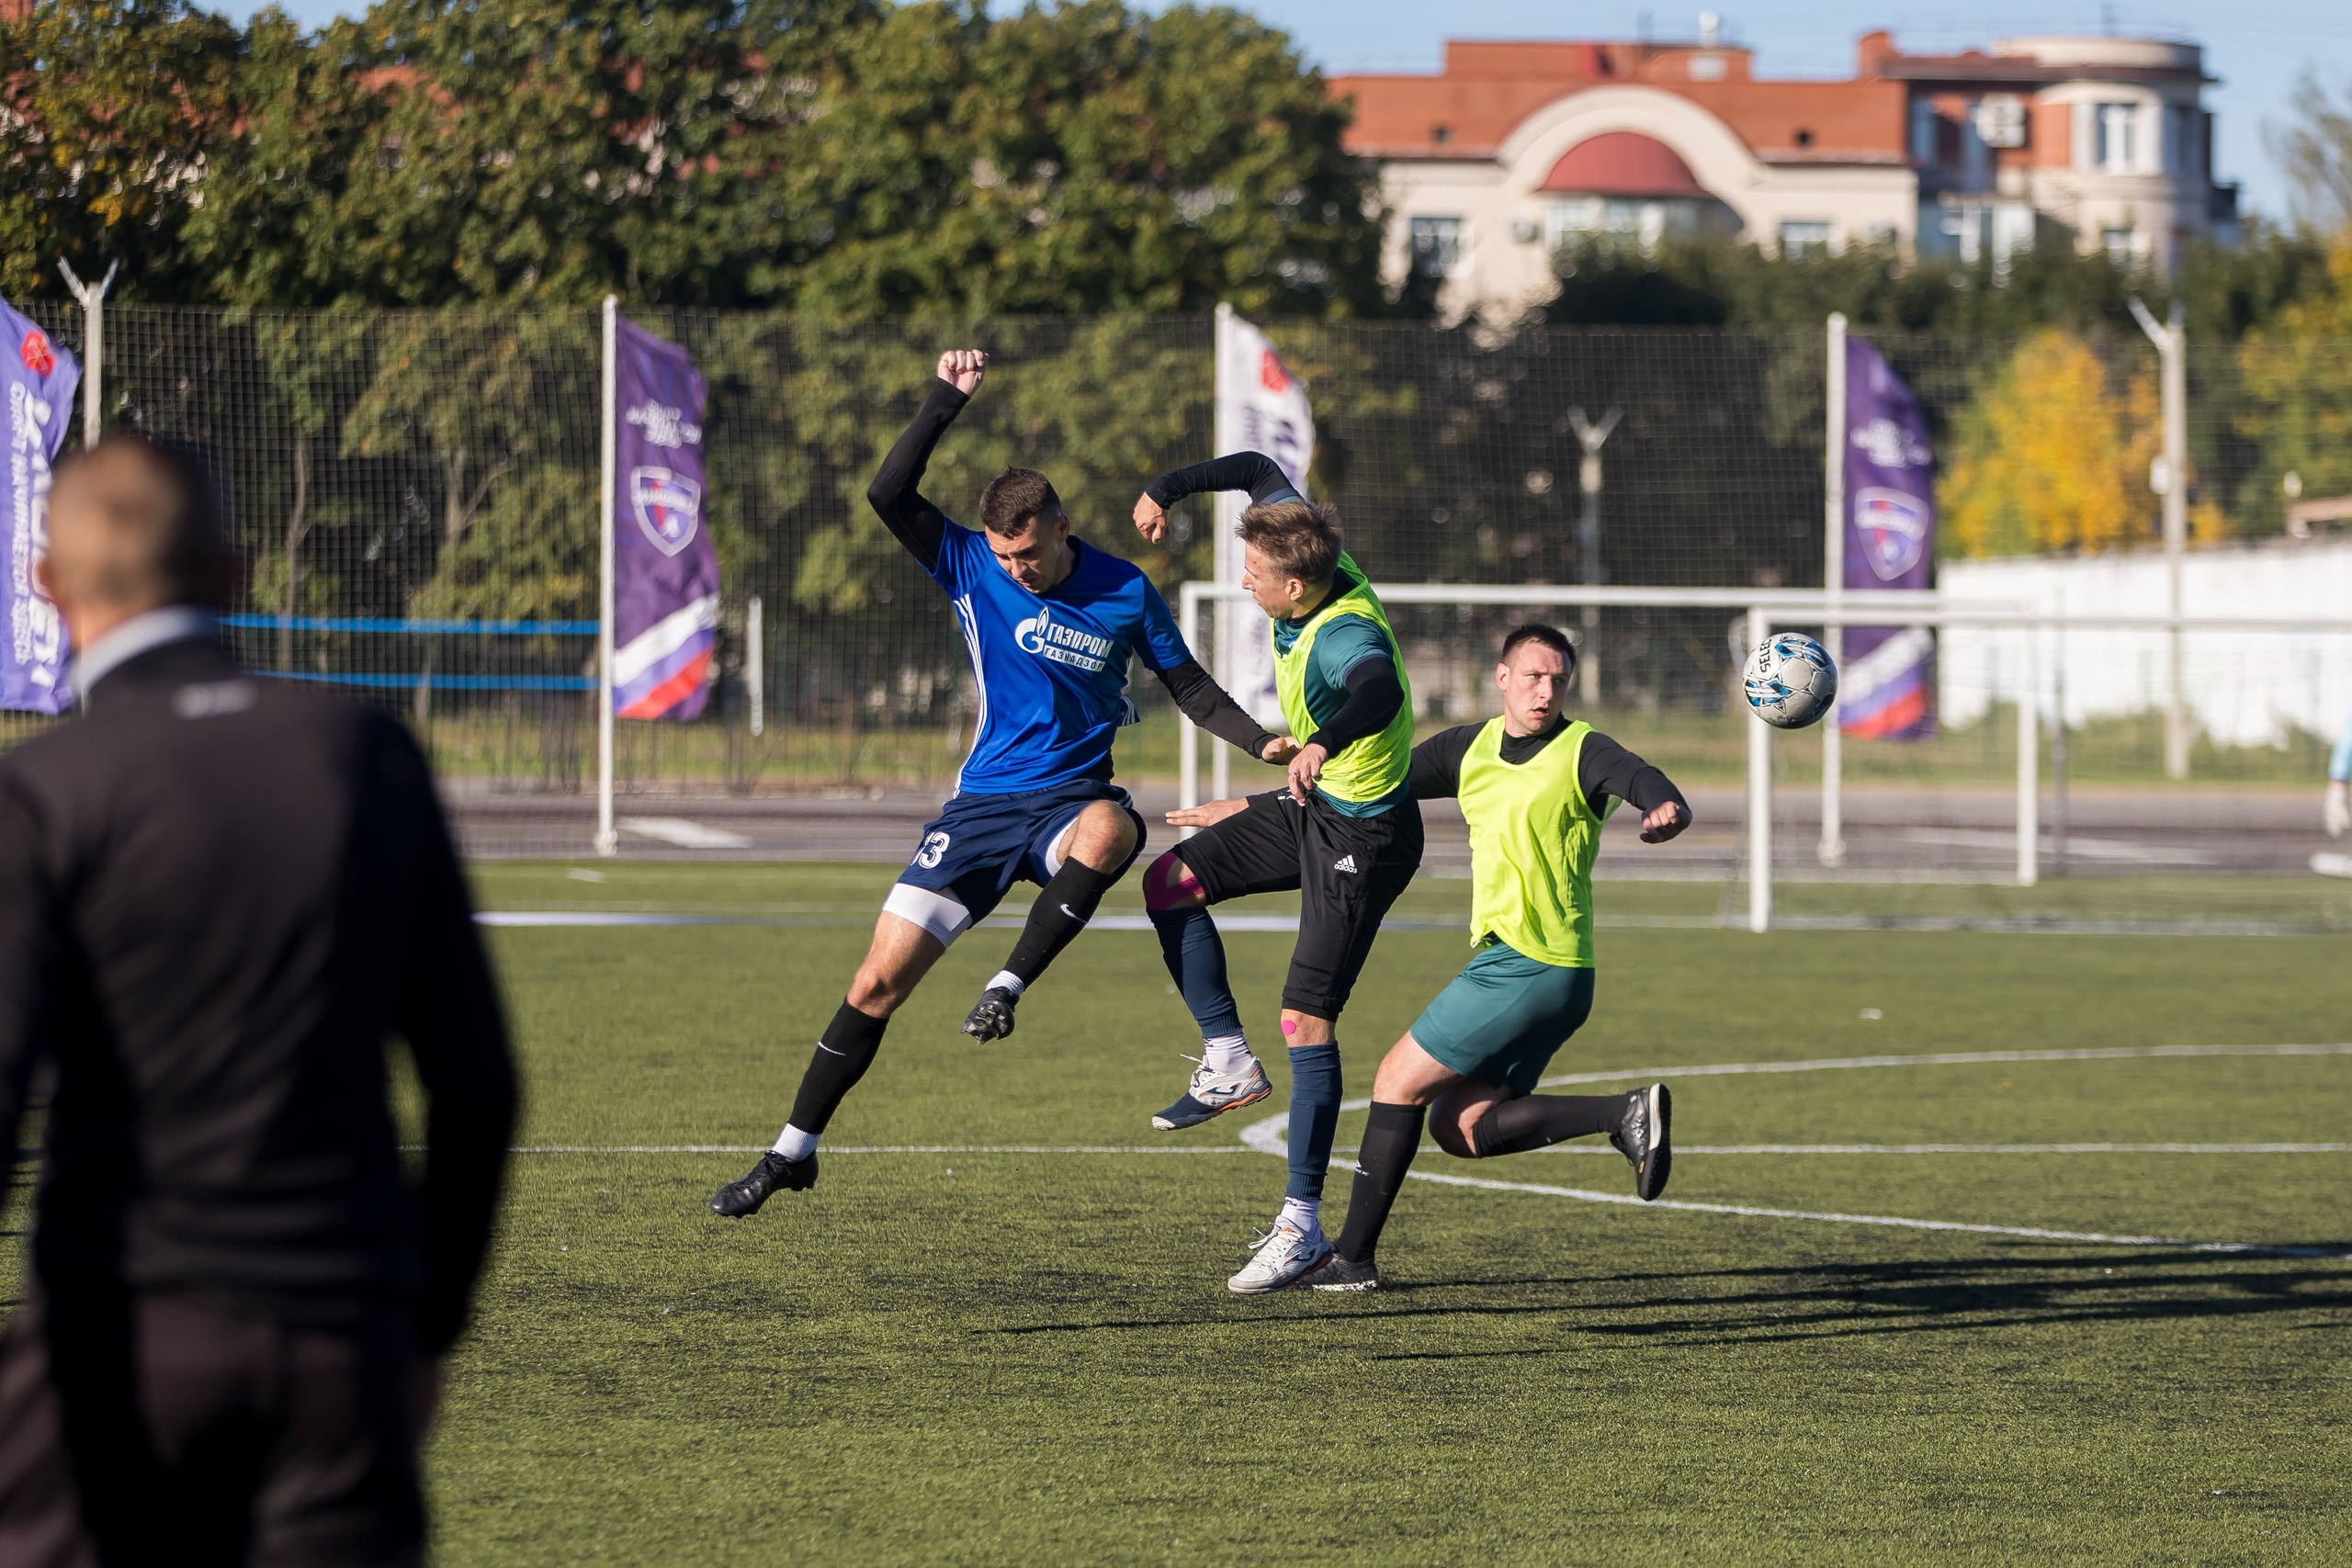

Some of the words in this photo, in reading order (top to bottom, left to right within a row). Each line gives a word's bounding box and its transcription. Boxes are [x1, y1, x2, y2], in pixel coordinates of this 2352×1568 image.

[1046, 623, 1114, 658] ГАЗПРОМ
[1045, 647, 1104, 671] ГАЗНАДЗОР
[1758, 638, 1772, 673] SELEC
[1334, 863, 1358, 874] adidas
